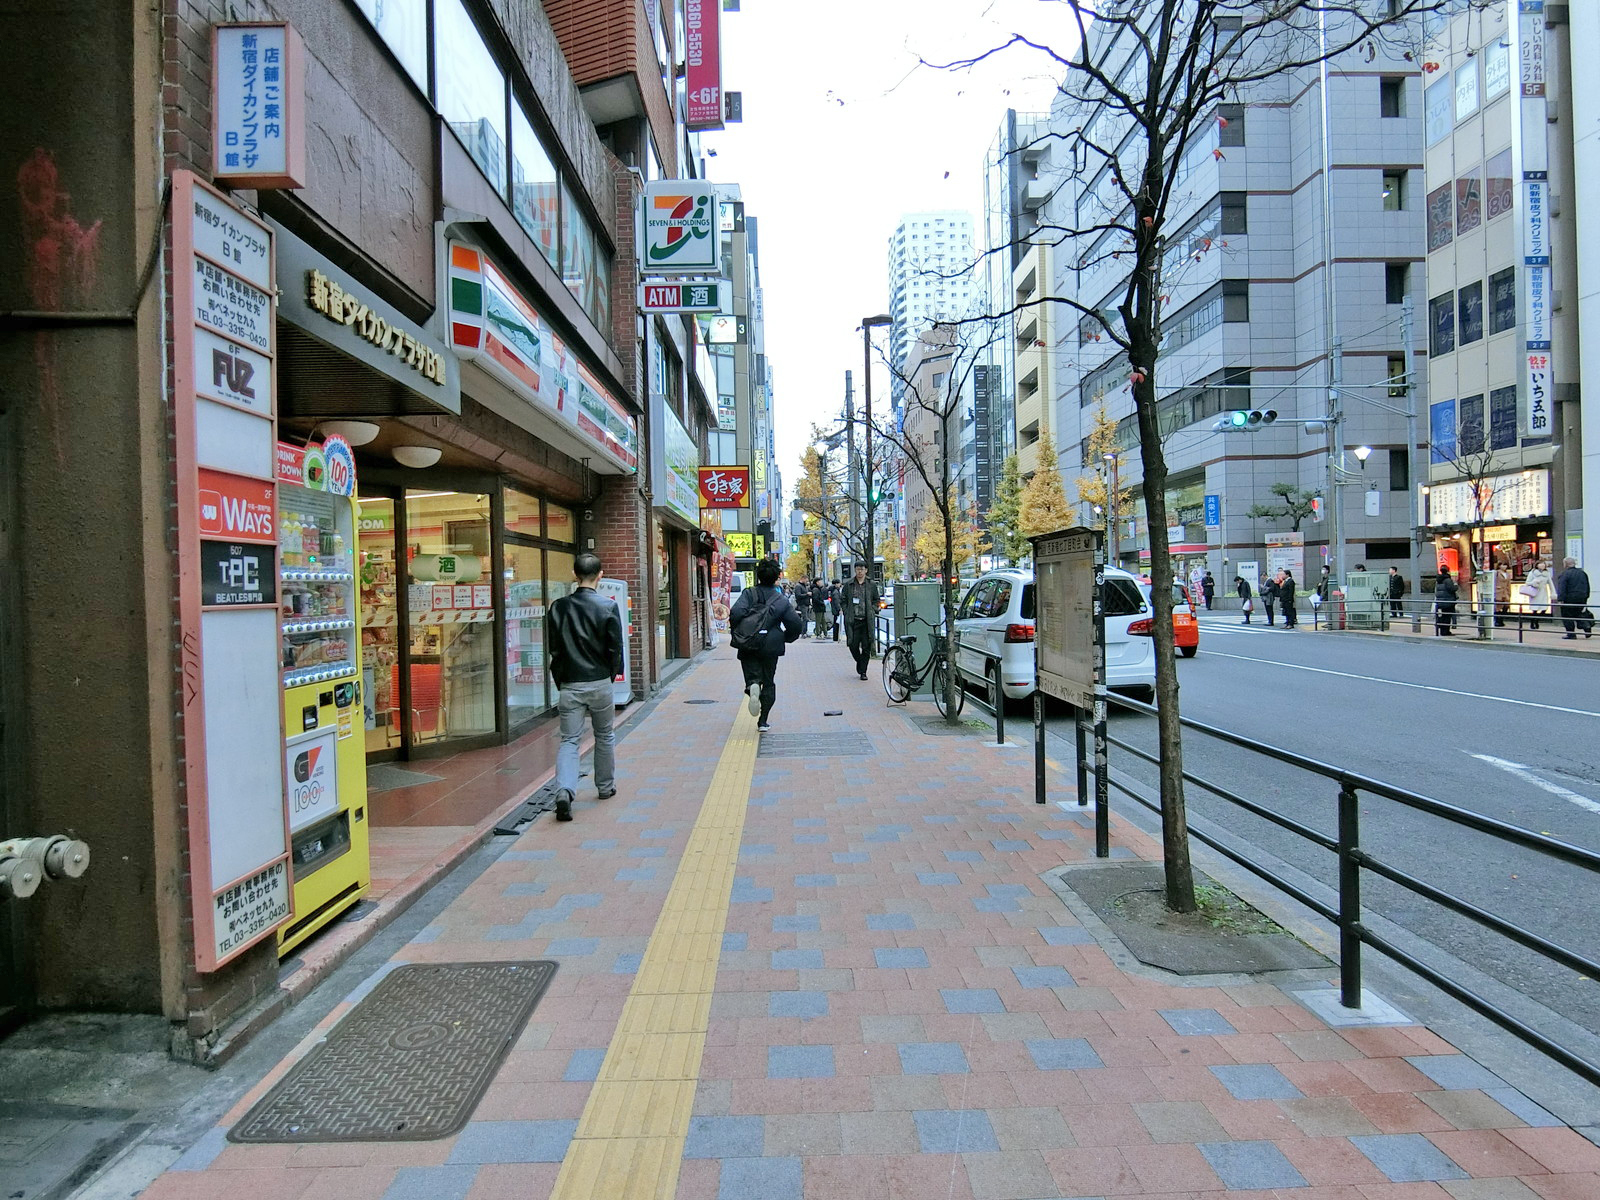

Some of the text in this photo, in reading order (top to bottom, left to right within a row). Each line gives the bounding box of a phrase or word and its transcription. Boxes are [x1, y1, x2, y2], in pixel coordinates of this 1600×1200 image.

[1522, 41, 1531, 82] クリニック
[241, 33, 259, 169] 新宿ダイカンプラザ
[264, 47, 280, 138] 店舗ご案内
[700, 87, 719, 104] 6F
[1525, 83, 1541, 95] 5F
[225, 131, 240, 167] B館
[194, 201, 266, 258] 新宿ダイカンプラザ
[677, 219, 710, 227] HOLDINGS
[736, 213, 743, 222] 4
[222, 241, 242, 265] B館
[202, 278, 261, 317] お問い合わせ先
[648, 287, 709, 306] ATM 酒
[196, 307, 267, 348] TEL 03-3315-0420
[738, 324, 745, 334] 3
[228, 344, 241, 355] 6F
[1531, 373, 1547, 430] いち五郎
[330, 457, 347, 488] 100
[704, 470, 743, 498] すき家
[264, 489, 273, 499] 2F
[1207, 496, 1218, 525] 共栄ビル
[438, 556, 456, 574] 酒
[294, 780, 321, 813] 100
[223, 879, 279, 919] お問い合わせ先
[219, 902, 287, 954] TEL 03-3315-0420
